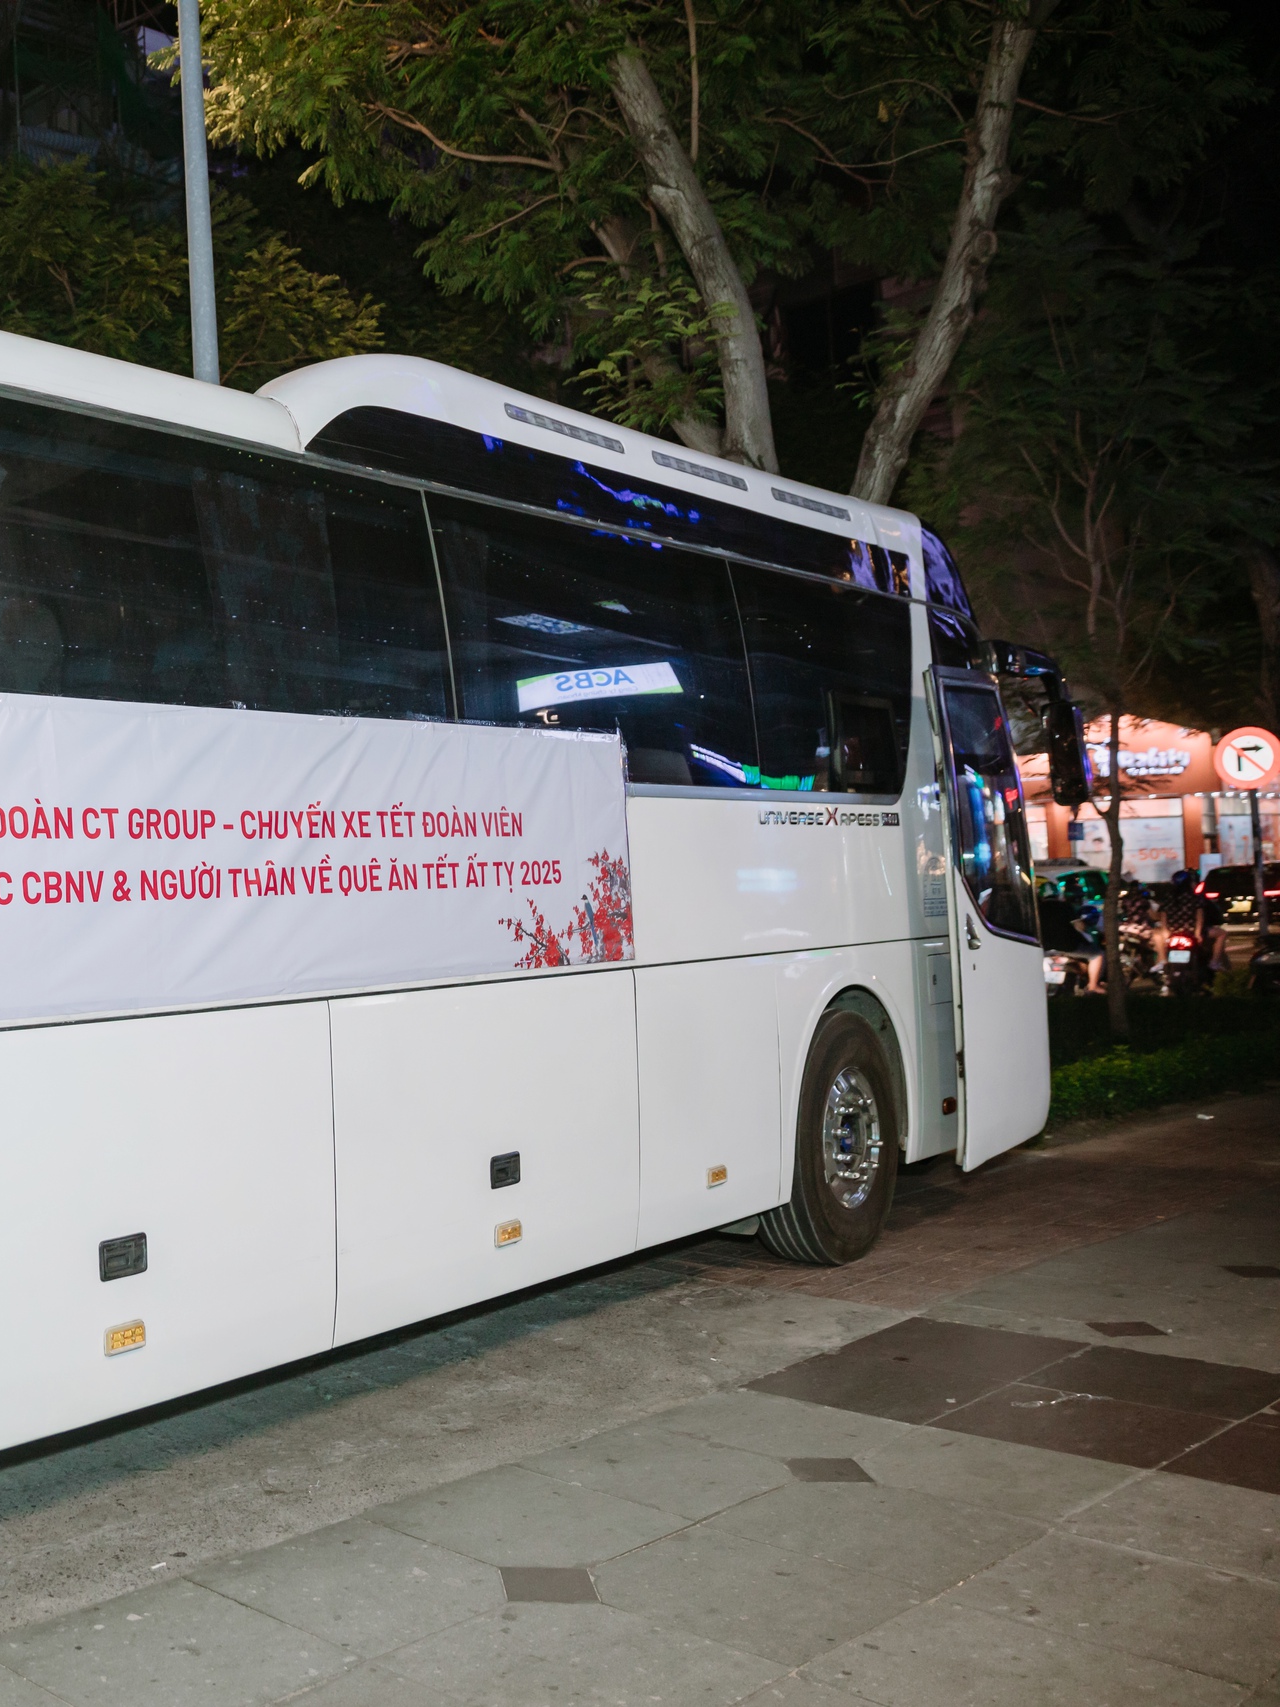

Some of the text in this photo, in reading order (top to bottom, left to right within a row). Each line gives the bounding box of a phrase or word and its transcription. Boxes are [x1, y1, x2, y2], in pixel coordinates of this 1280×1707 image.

[82, 808, 119, 840] CT
[128, 808, 216, 840] GROUP
[240, 801, 335, 840] CHUYẾN
[342, 811, 371, 838] XE
[376, 802, 417, 838] TẾT
[422, 804, 477, 838] ĐOÀN
[482, 806, 523, 837] VIÊN
[22, 871, 104, 904] CBNV
[113, 870, 131, 902] &
[140, 862, 221, 900] NGƯỜI
[228, 860, 295, 897] THÂN
[302, 855, 333, 894] VỀ
[339, 858, 382, 896] QUÊ
[388, 859, 417, 891] ĂN
[422, 856, 460, 889] TẾT
[466, 853, 490, 888] ẤT
[493, 861, 515, 893] TỴ
[520, 860, 562, 887] 2025
